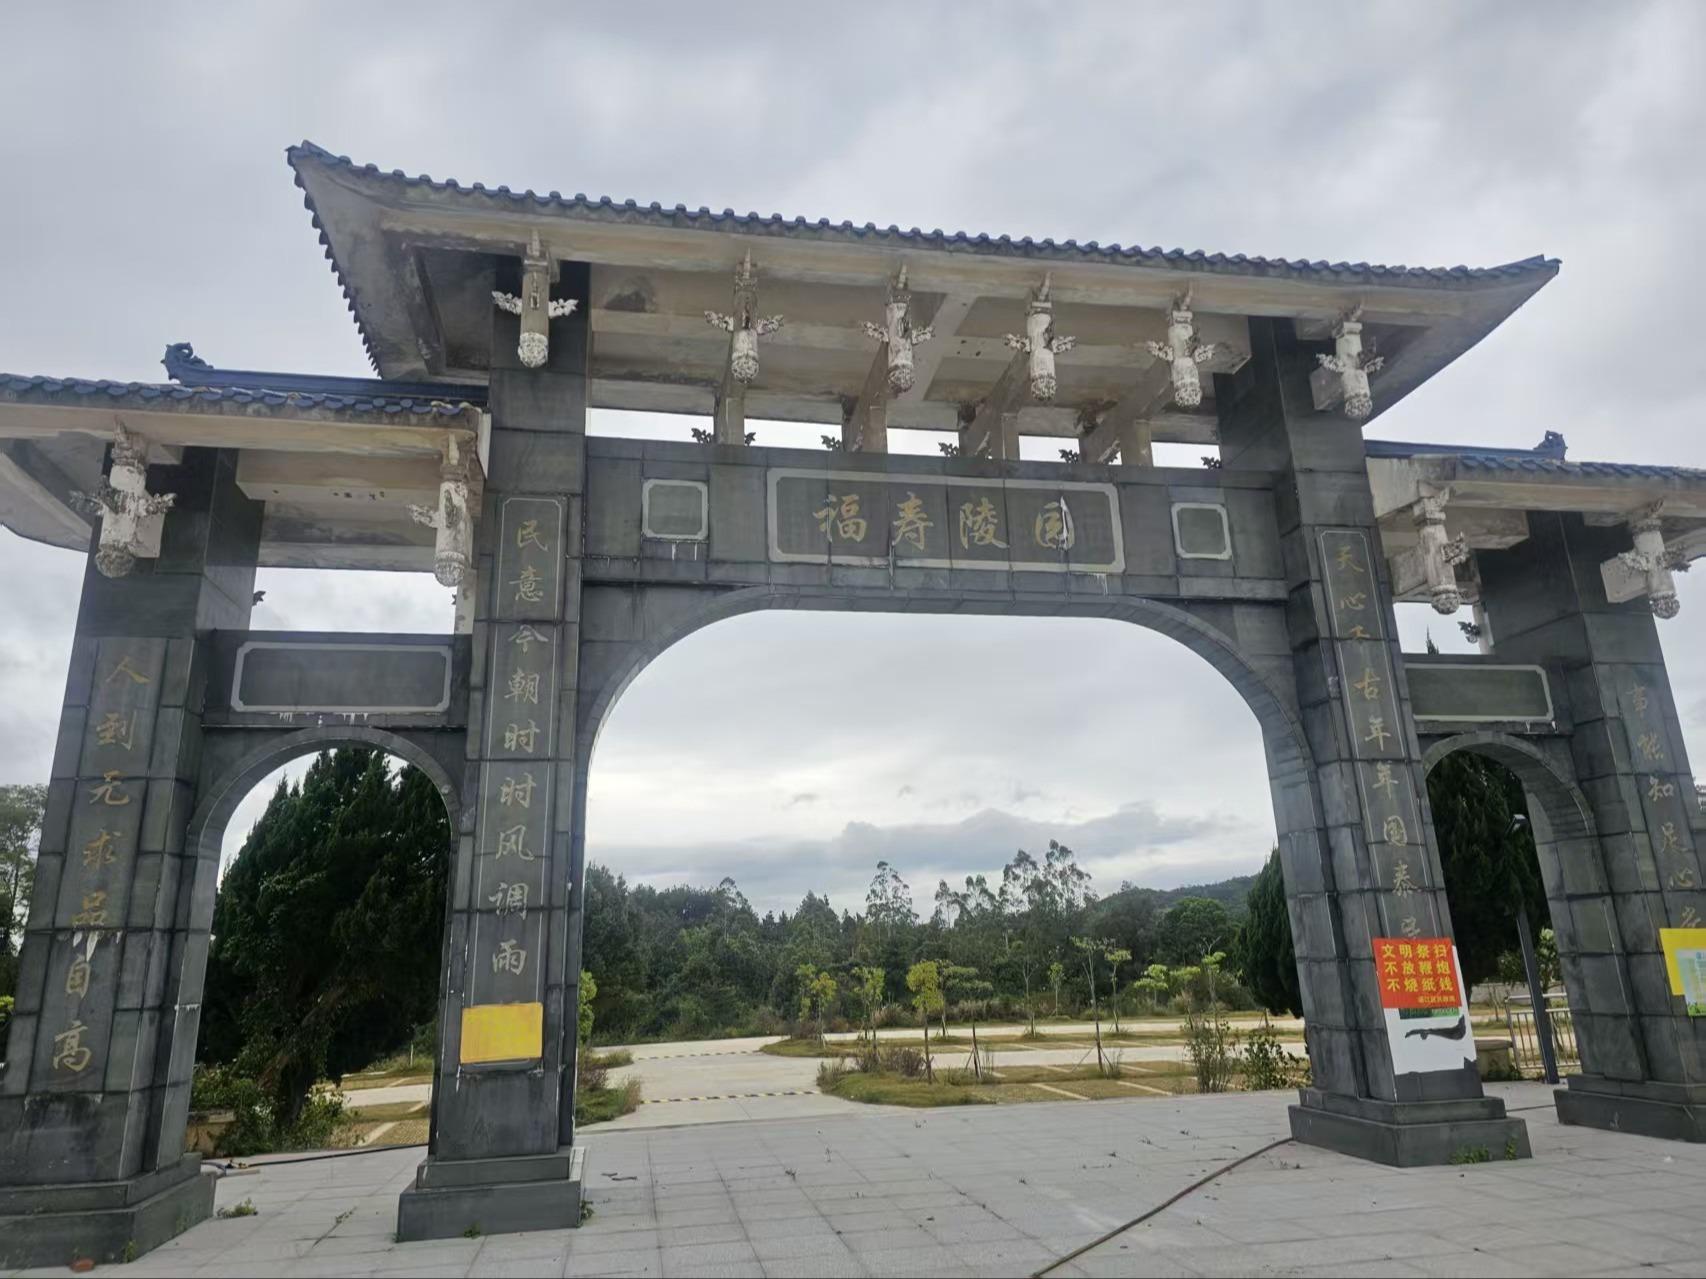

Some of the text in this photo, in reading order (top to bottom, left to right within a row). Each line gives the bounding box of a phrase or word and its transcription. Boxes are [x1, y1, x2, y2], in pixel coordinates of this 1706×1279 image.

[488, 520, 549, 976] 民意今朝时时风调雨
[53, 656, 152, 1072] 人到无求品自高
[1382, 944, 1448, 959] 文明祭扫
[1384, 960, 1451, 975] 不放鞭炮
[1386, 976, 1454, 993] 不烧纸钱
